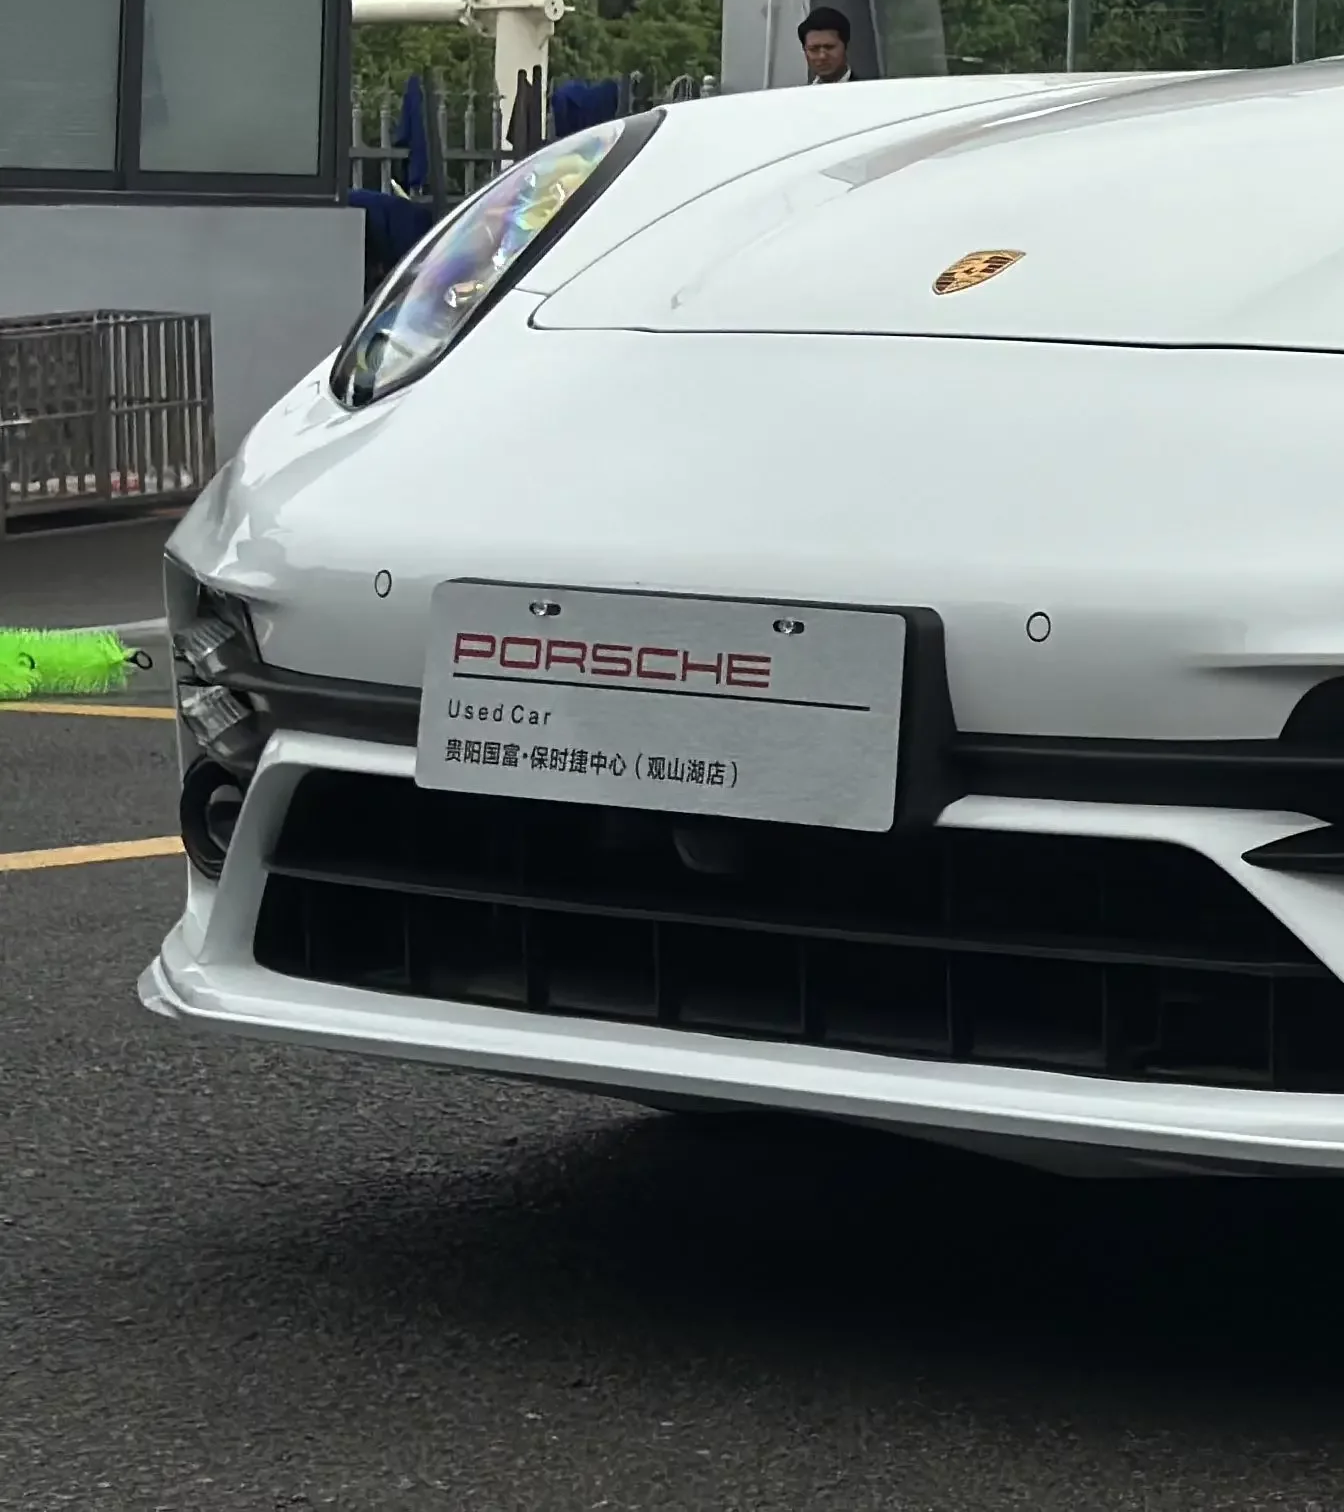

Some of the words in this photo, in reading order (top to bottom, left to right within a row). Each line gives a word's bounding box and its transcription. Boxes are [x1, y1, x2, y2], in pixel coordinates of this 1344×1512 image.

[453, 632, 772, 688] PORSCHE
[448, 698, 503, 723] Used
[511, 704, 552, 725] Car
